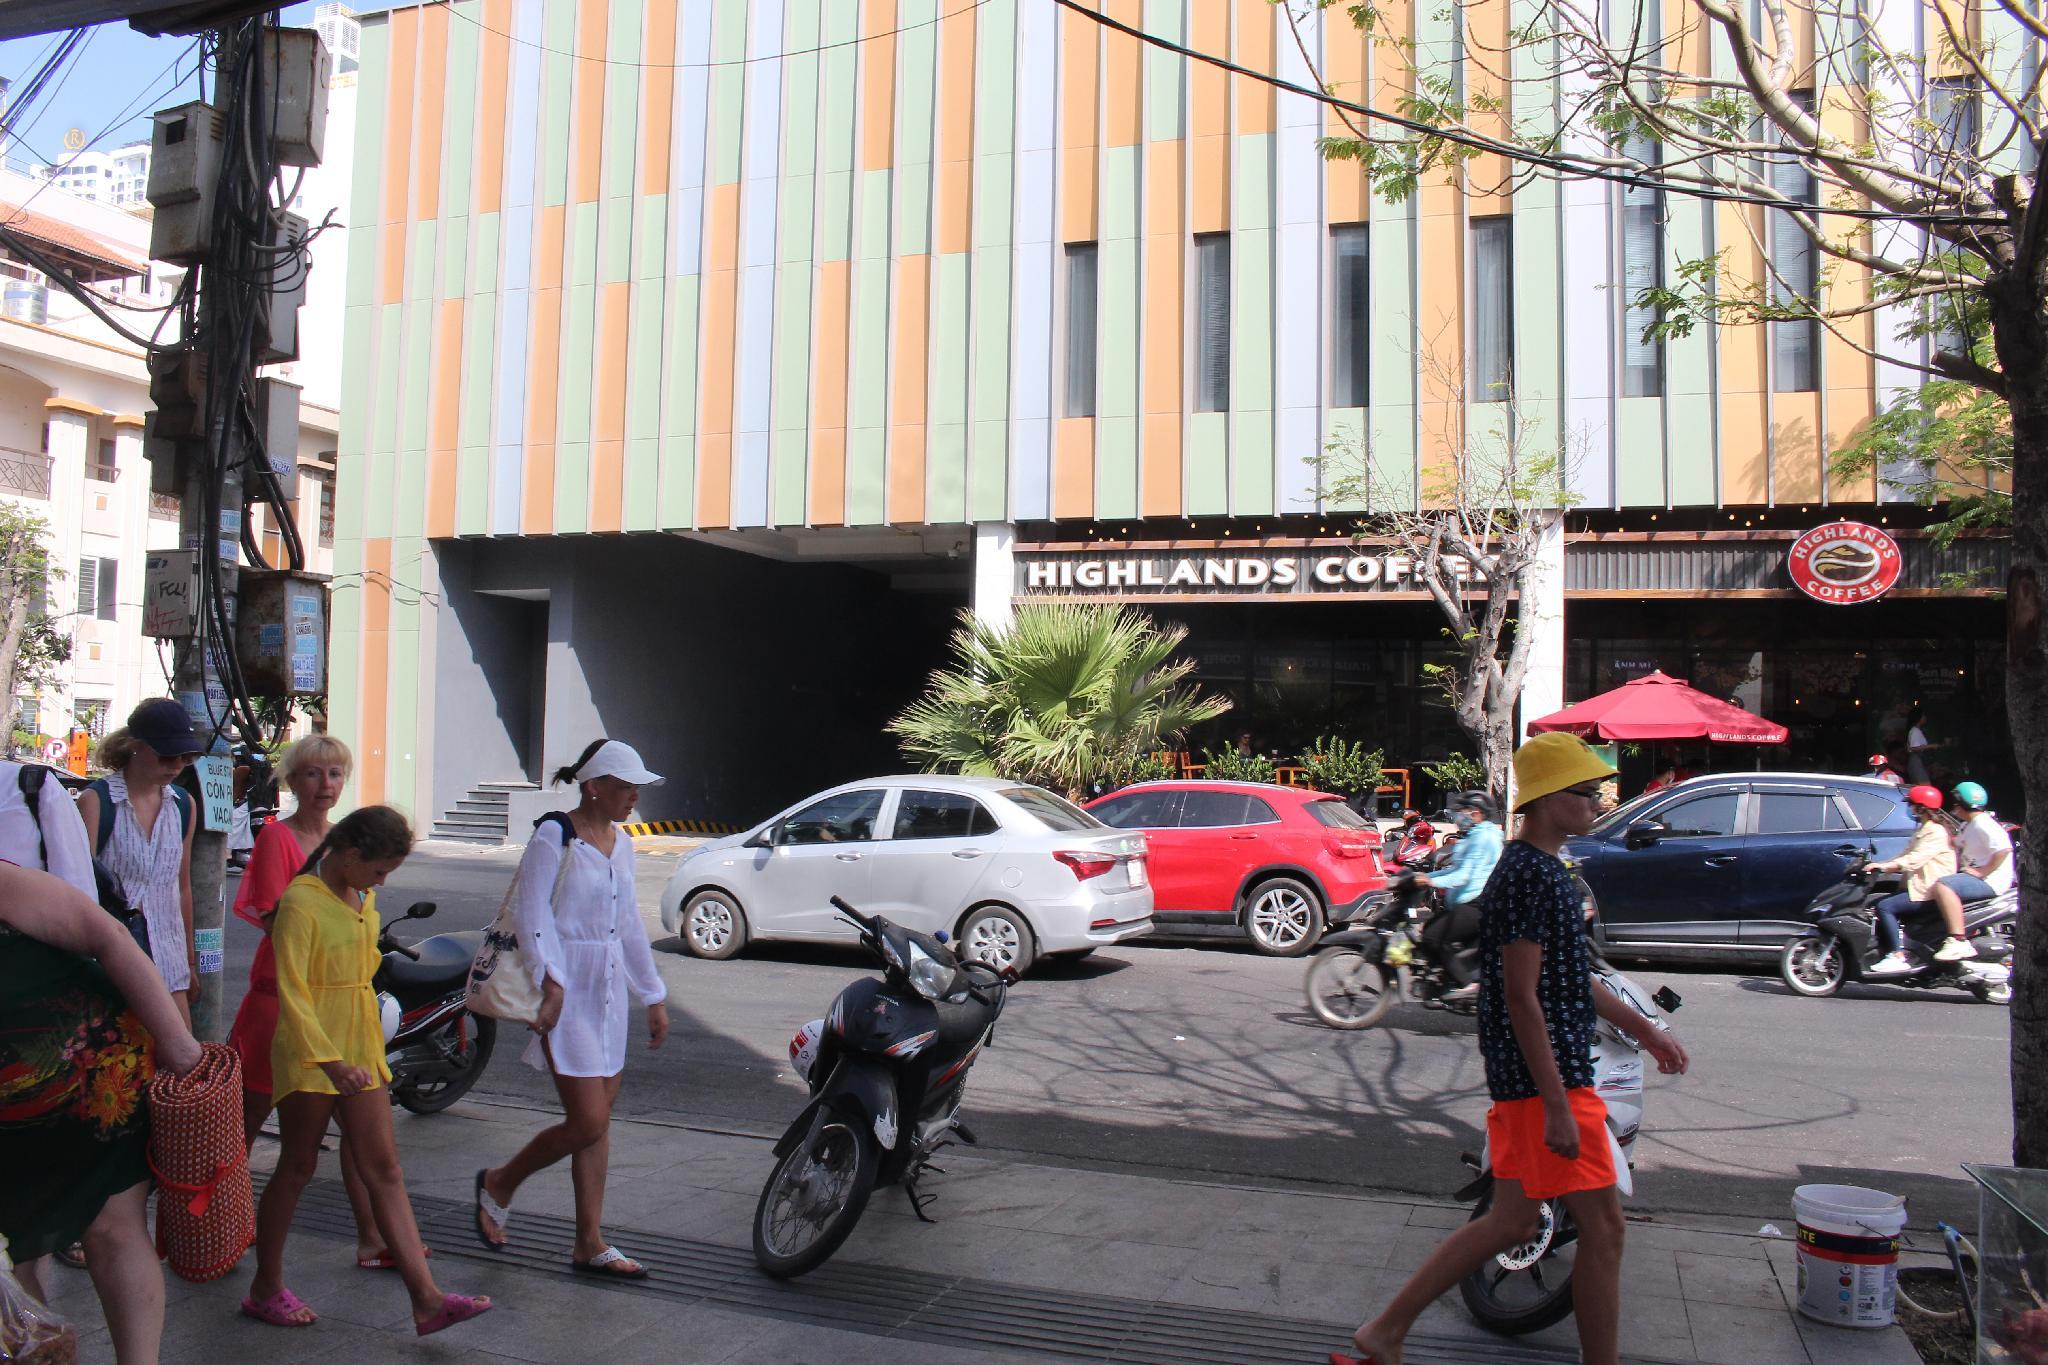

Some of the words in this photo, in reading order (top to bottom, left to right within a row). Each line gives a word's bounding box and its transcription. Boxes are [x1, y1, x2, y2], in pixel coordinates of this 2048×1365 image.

[1795, 527, 1895, 559] HIGHLANDS
[1028, 557, 1299, 587] HIGHLANDS
[1807, 579, 1884, 599] COFFEE
[208, 763, 223, 776] BLUE
[206, 778, 225, 799] CÒN
